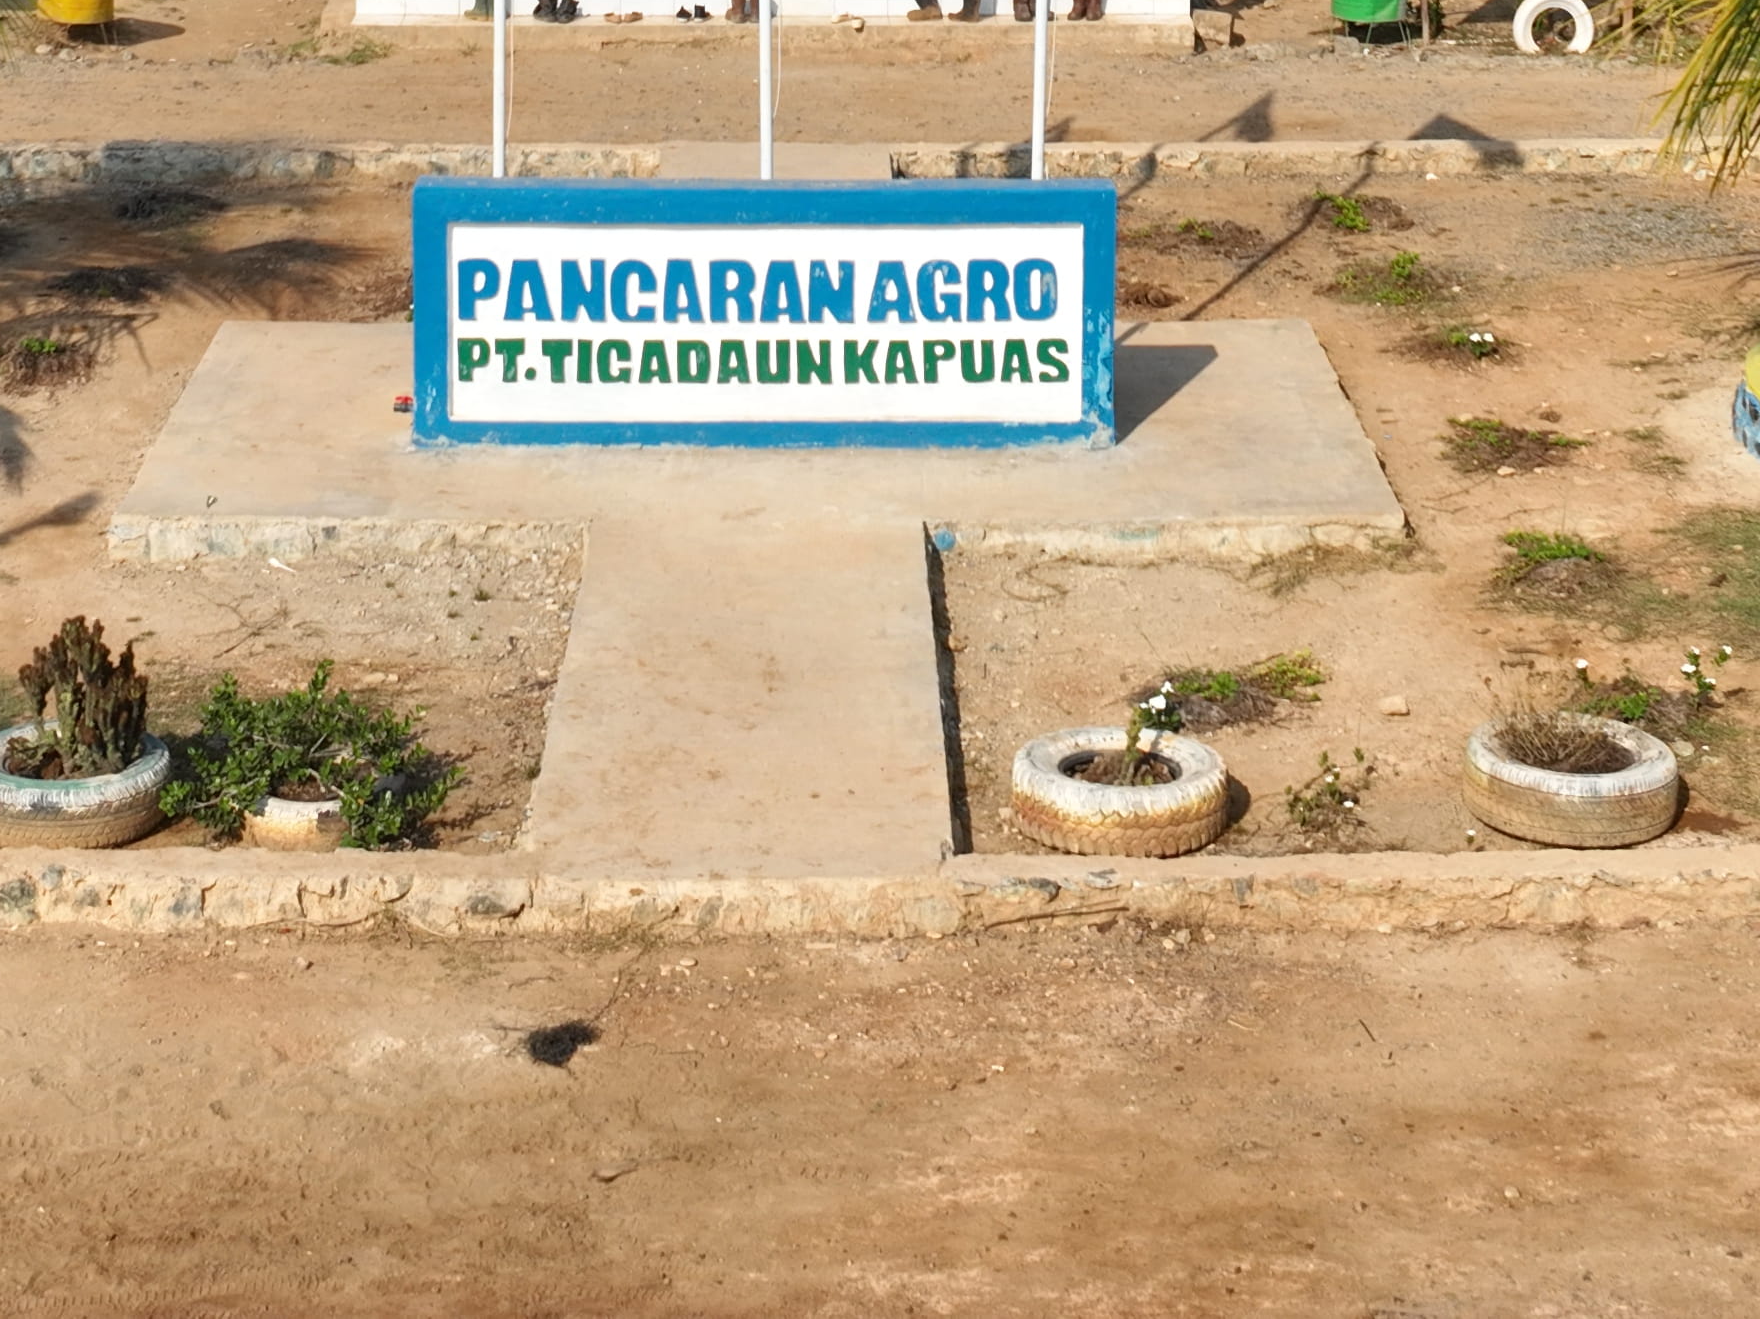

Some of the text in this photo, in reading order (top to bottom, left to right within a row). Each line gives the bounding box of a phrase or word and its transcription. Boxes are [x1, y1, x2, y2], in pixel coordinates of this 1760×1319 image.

[457, 258, 1059, 323] PANCARAN AGRO
[457, 337, 537, 383] PT.
[843, 338, 1070, 383] KAPUAS
